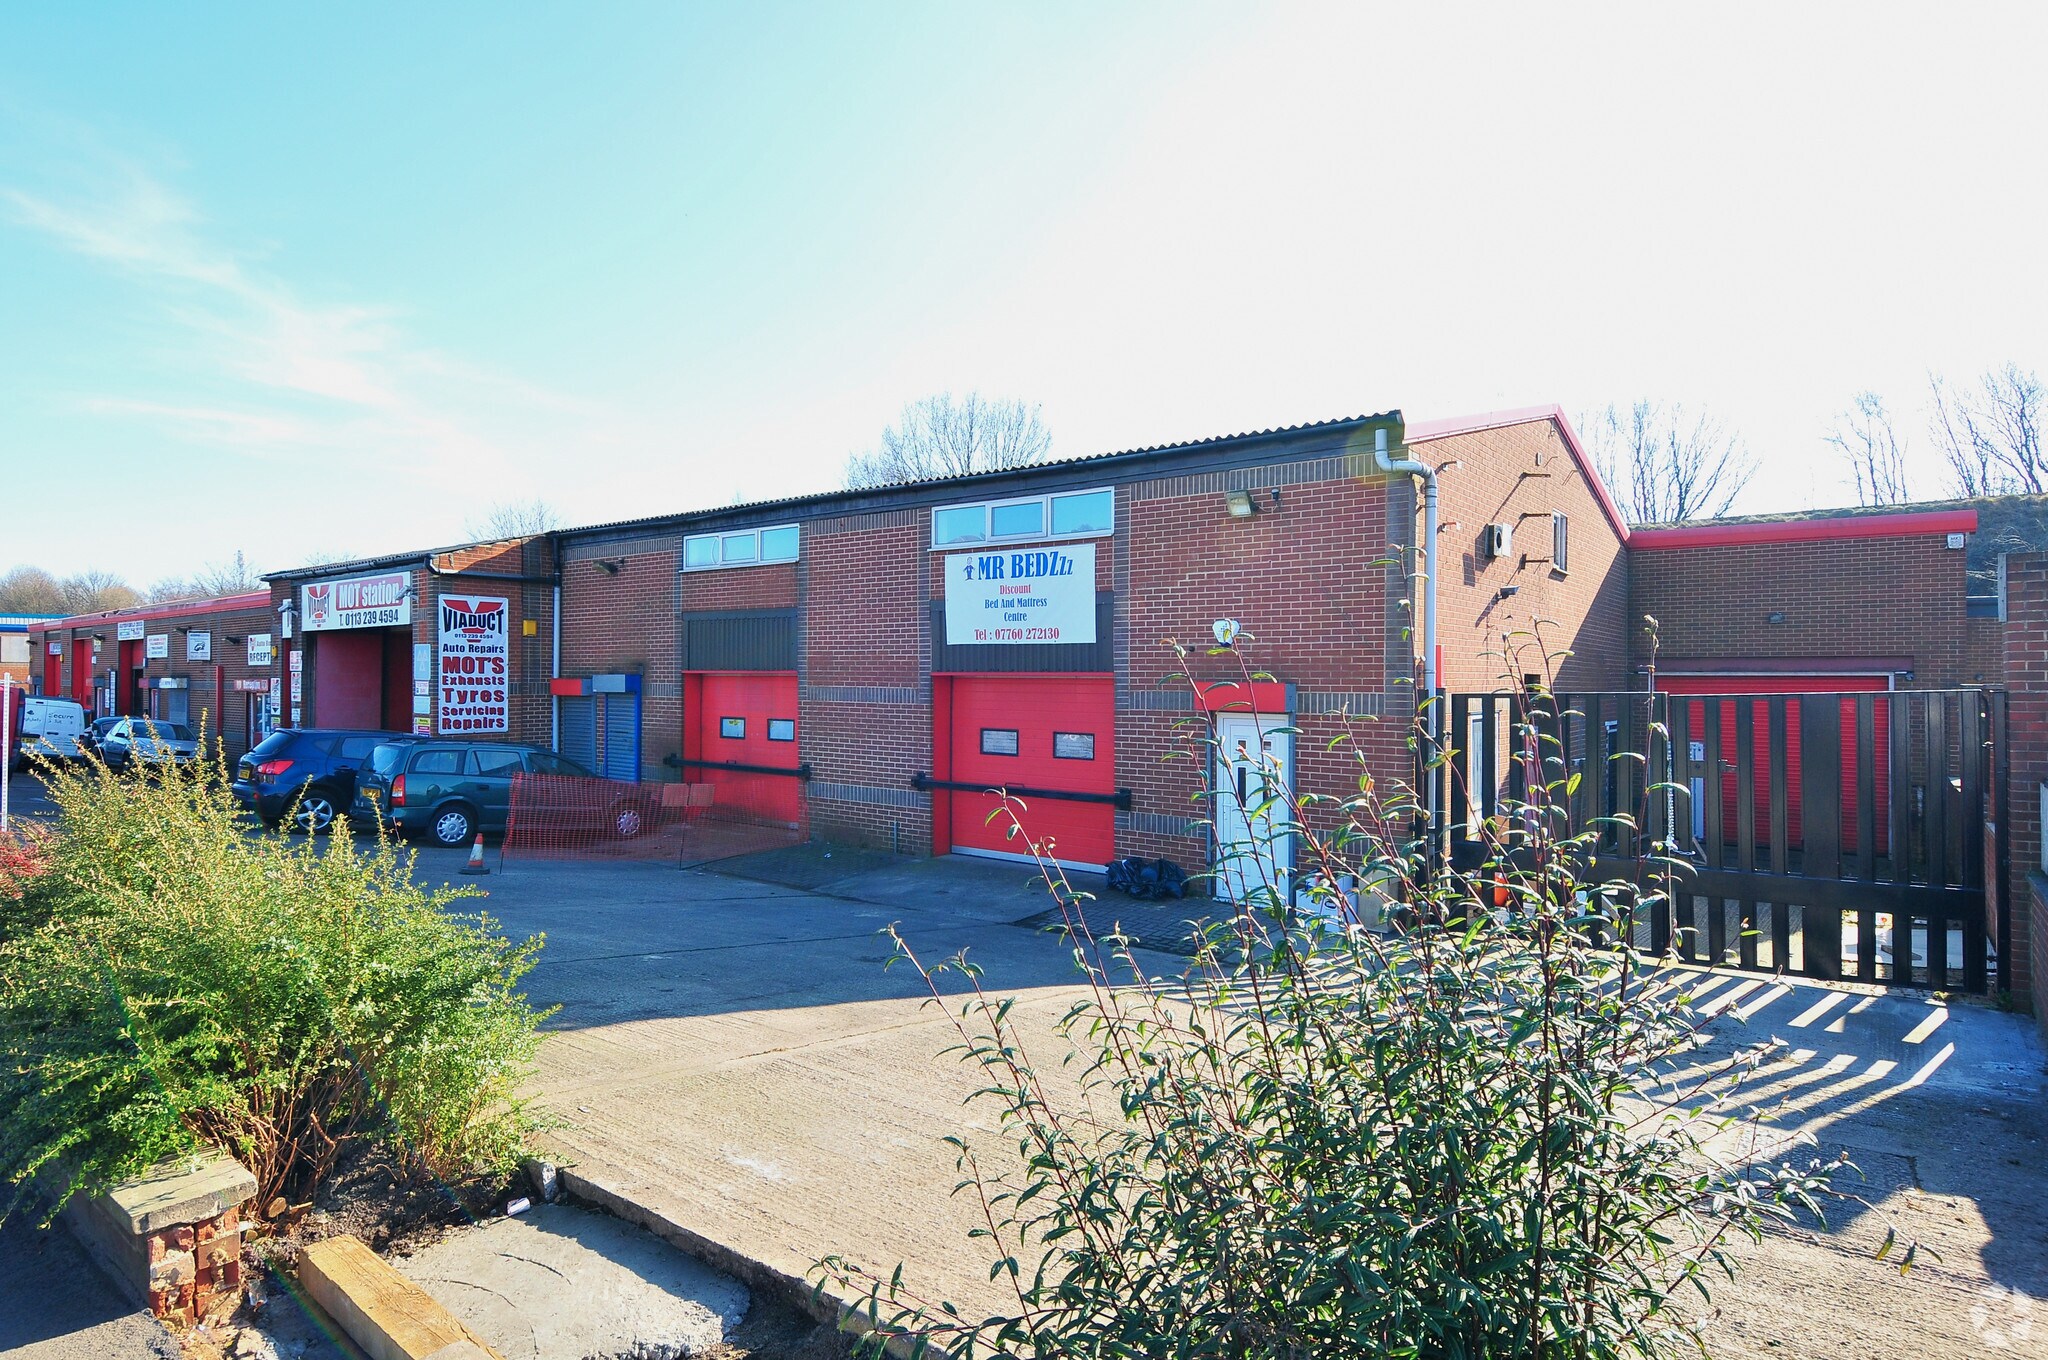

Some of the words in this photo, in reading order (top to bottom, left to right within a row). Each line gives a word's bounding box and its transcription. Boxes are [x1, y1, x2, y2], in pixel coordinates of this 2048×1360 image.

[978, 555, 1005, 580] MR
[339, 583, 361, 609] MOT
[362, 580, 400, 608] station
[999, 584, 1032, 595] Discount
[984, 599, 999, 609] Bed
[1000, 598, 1015, 608] And
[1016, 597, 1048, 608] Mattress
[345, 612, 362, 626] 0113
[363, 611, 377, 625] 239
[378, 609, 399, 623] 4594
[442, 605, 504, 635] VIADUCT
[1003, 611, 1028, 622] Centre
[974, 629, 987, 641] Tel
[995, 628, 1023, 640] 07760
[1025, 627, 1060, 640] 272130
[442, 643, 465, 653] Auto
[468, 644, 505, 654] Repairs
[442, 656, 505, 675] MOT'S
[442, 675, 505, 686] Exhausts
[442, 688, 505, 704] Tyres
[442, 706, 505, 716] Servicing
[442, 717, 505, 731] Repairs
